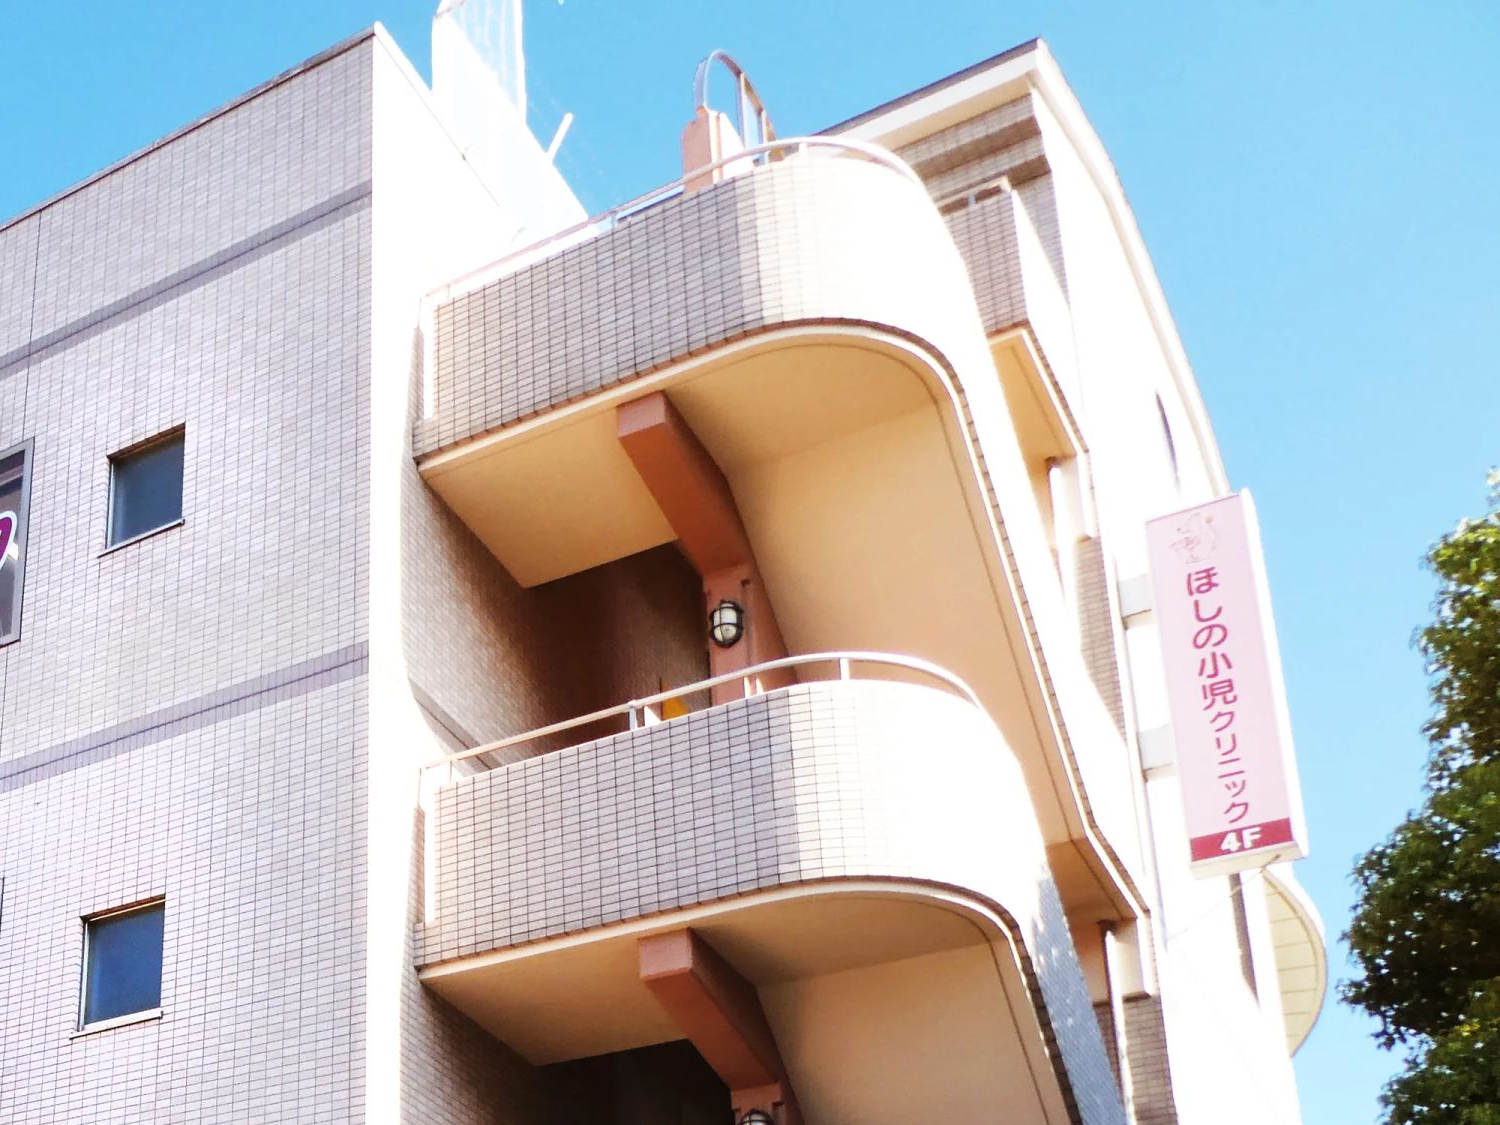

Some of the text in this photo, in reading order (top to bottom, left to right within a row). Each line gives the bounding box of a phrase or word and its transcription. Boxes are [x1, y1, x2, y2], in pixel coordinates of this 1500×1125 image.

[1185, 566, 1250, 825] ほしの小児クリニック
[1220, 826, 1262, 852] 4F
